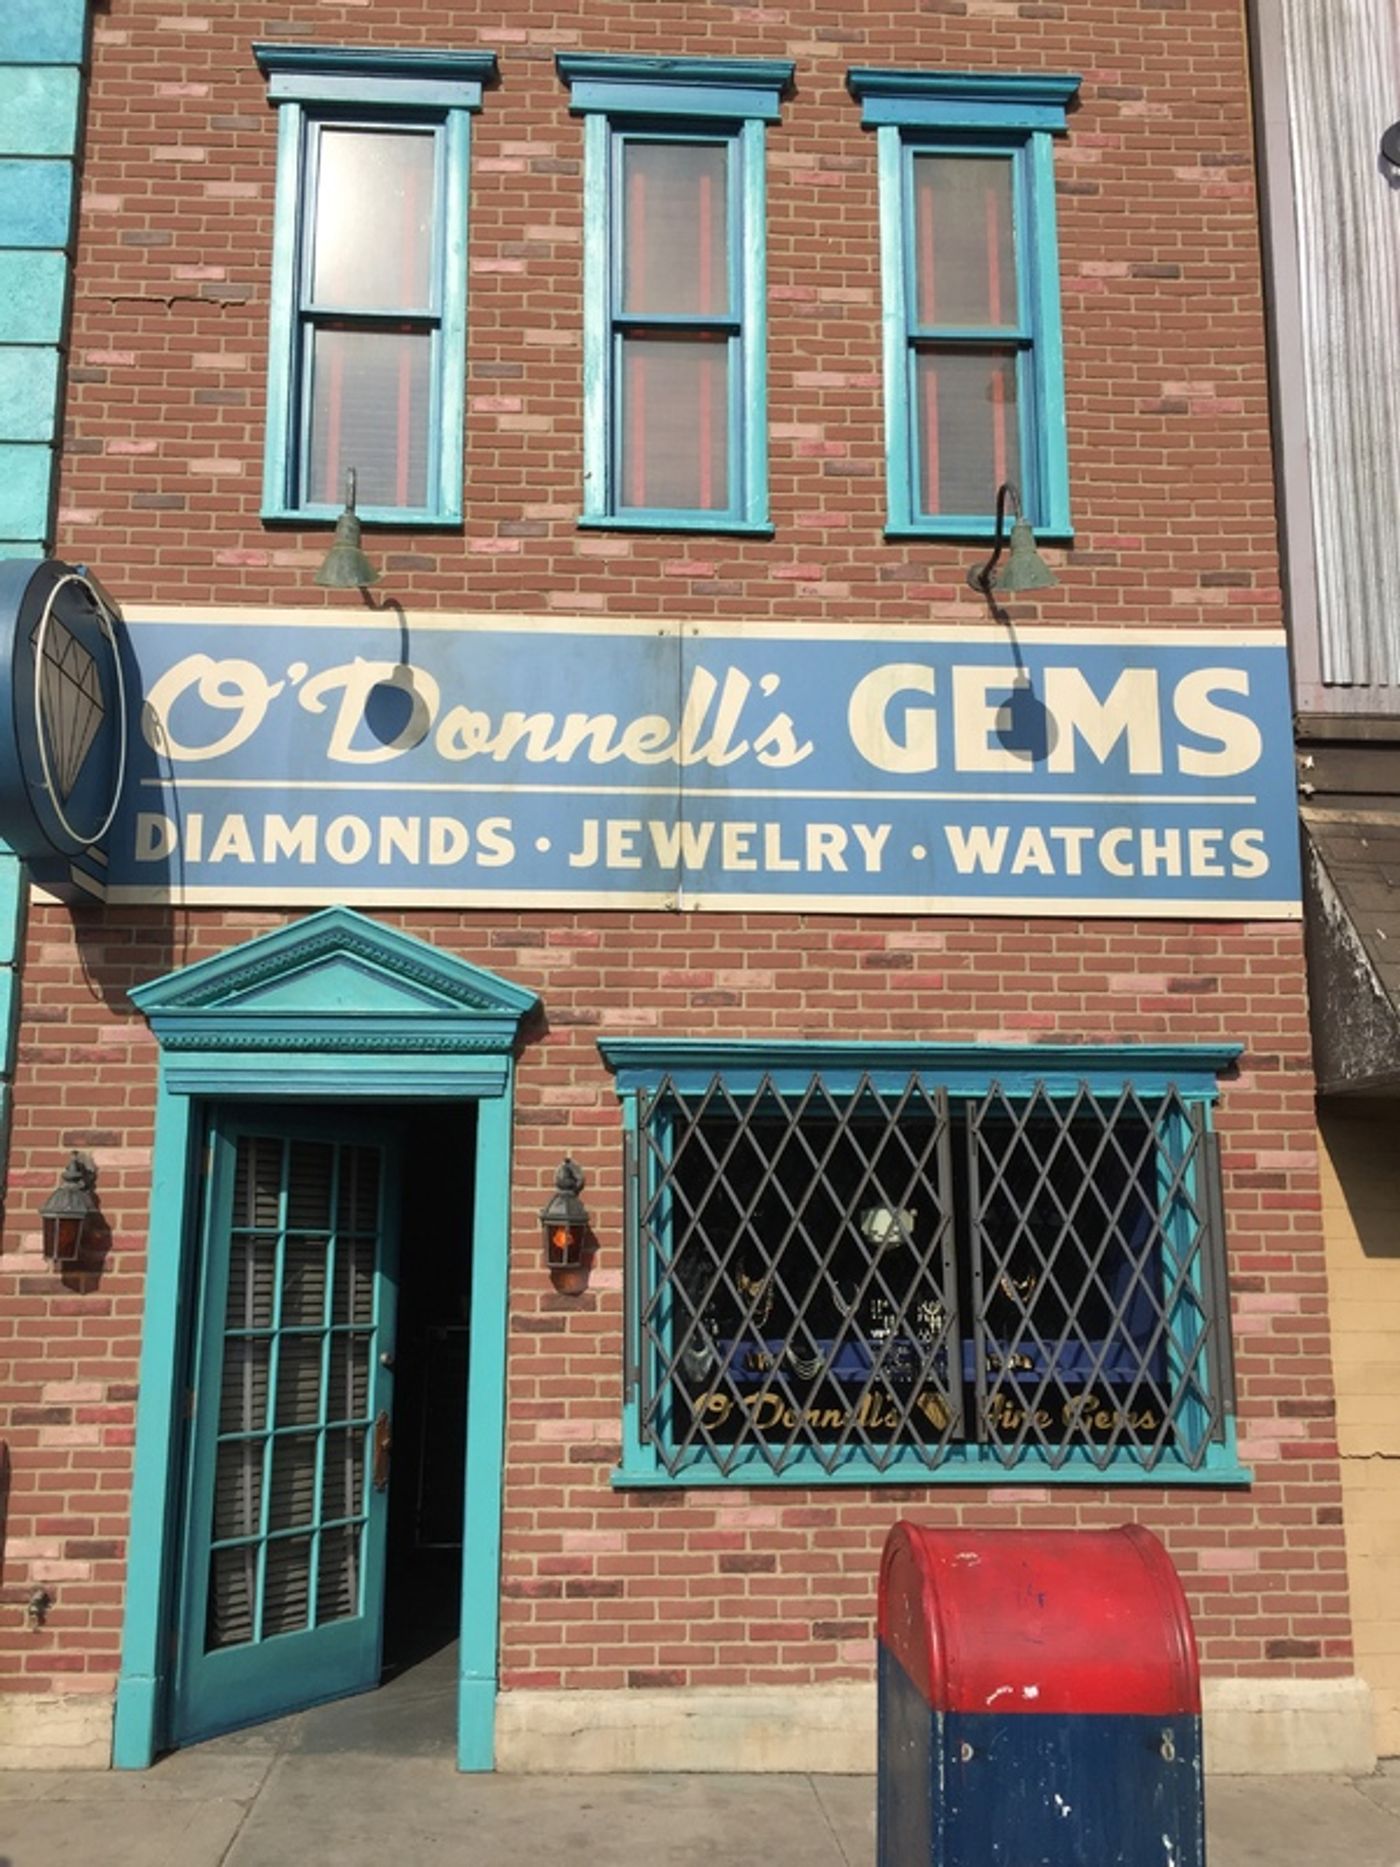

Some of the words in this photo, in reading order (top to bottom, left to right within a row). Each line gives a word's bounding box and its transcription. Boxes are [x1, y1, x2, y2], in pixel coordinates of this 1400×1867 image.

[142, 654, 814, 766] O'Donnell's
[848, 663, 1263, 777] GEMS
[135, 813, 515, 868] DIAMONDS
[568, 820, 893, 873] JEWELRY
[945, 827, 1270, 879] WATCHES
